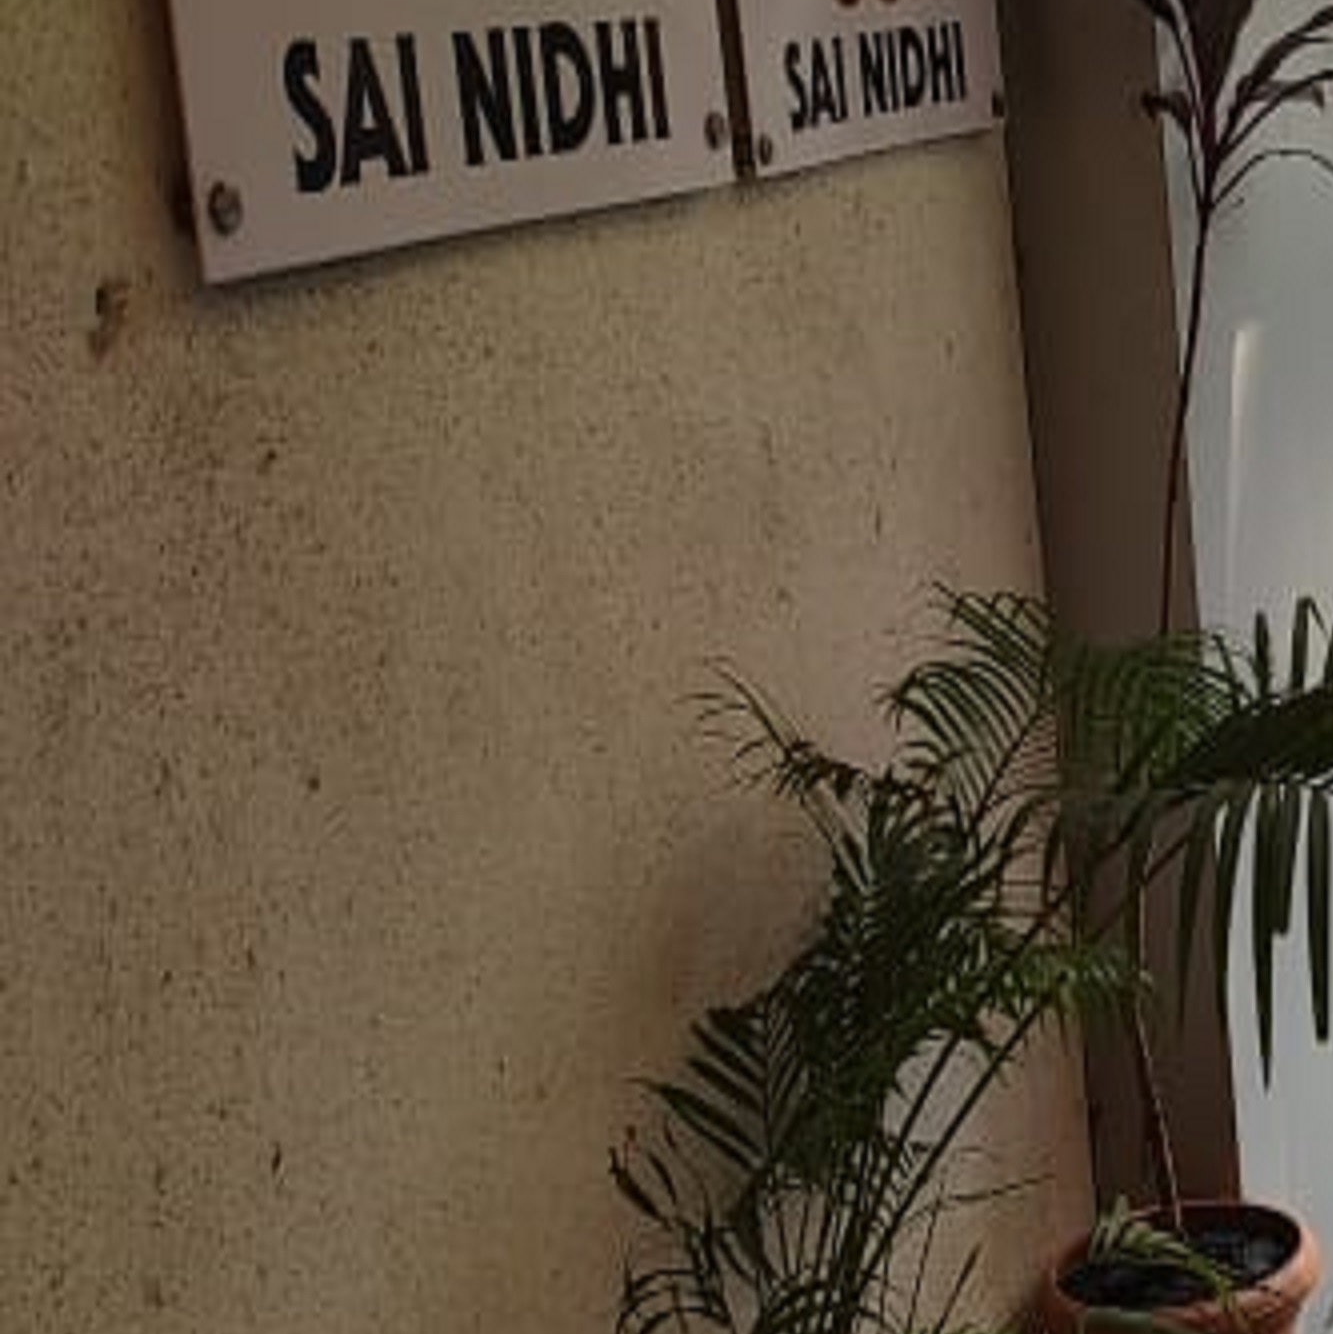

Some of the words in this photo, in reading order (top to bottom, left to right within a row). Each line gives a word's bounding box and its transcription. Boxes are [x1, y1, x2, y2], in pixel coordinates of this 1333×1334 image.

[283, 27, 430, 194] SAI
[451, 18, 670, 167] NIDHI
[784, 34, 849, 133] SAI
[857, 20, 969, 118] NIDHI
